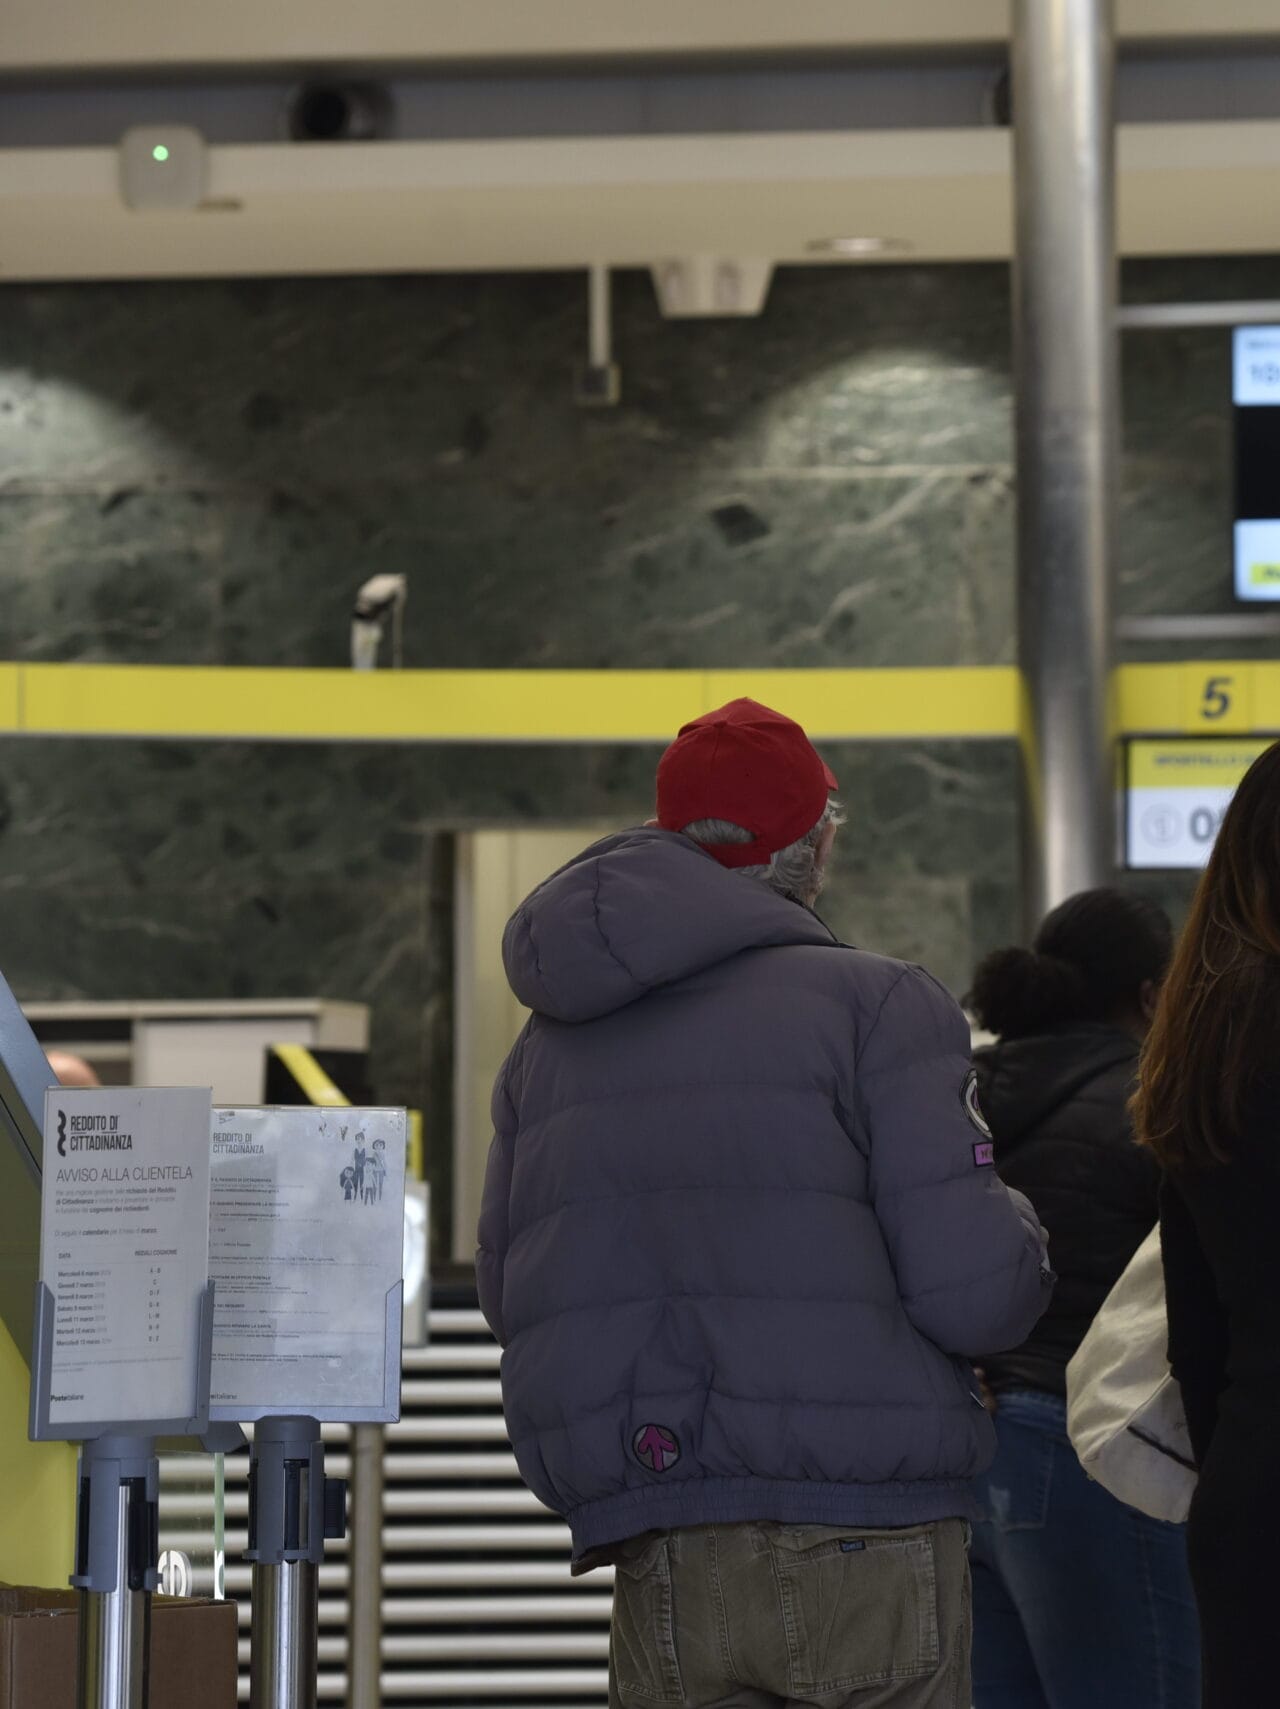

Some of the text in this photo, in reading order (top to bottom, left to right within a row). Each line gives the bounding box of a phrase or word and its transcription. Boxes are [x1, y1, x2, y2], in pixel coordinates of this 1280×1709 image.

[1201, 676, 1234, 720] 5
[70, 1115, 118, 1131] REDDITO DI
[70, 1135, 133, 1151] CITTADINANZA
[213, 1132, 252, 1142] REDDITO DI
[212, 1144, 264, 1154] CITTADINANZA
[56, 1165, 193, 1183] AVVISO ALLA CLIENTELA
